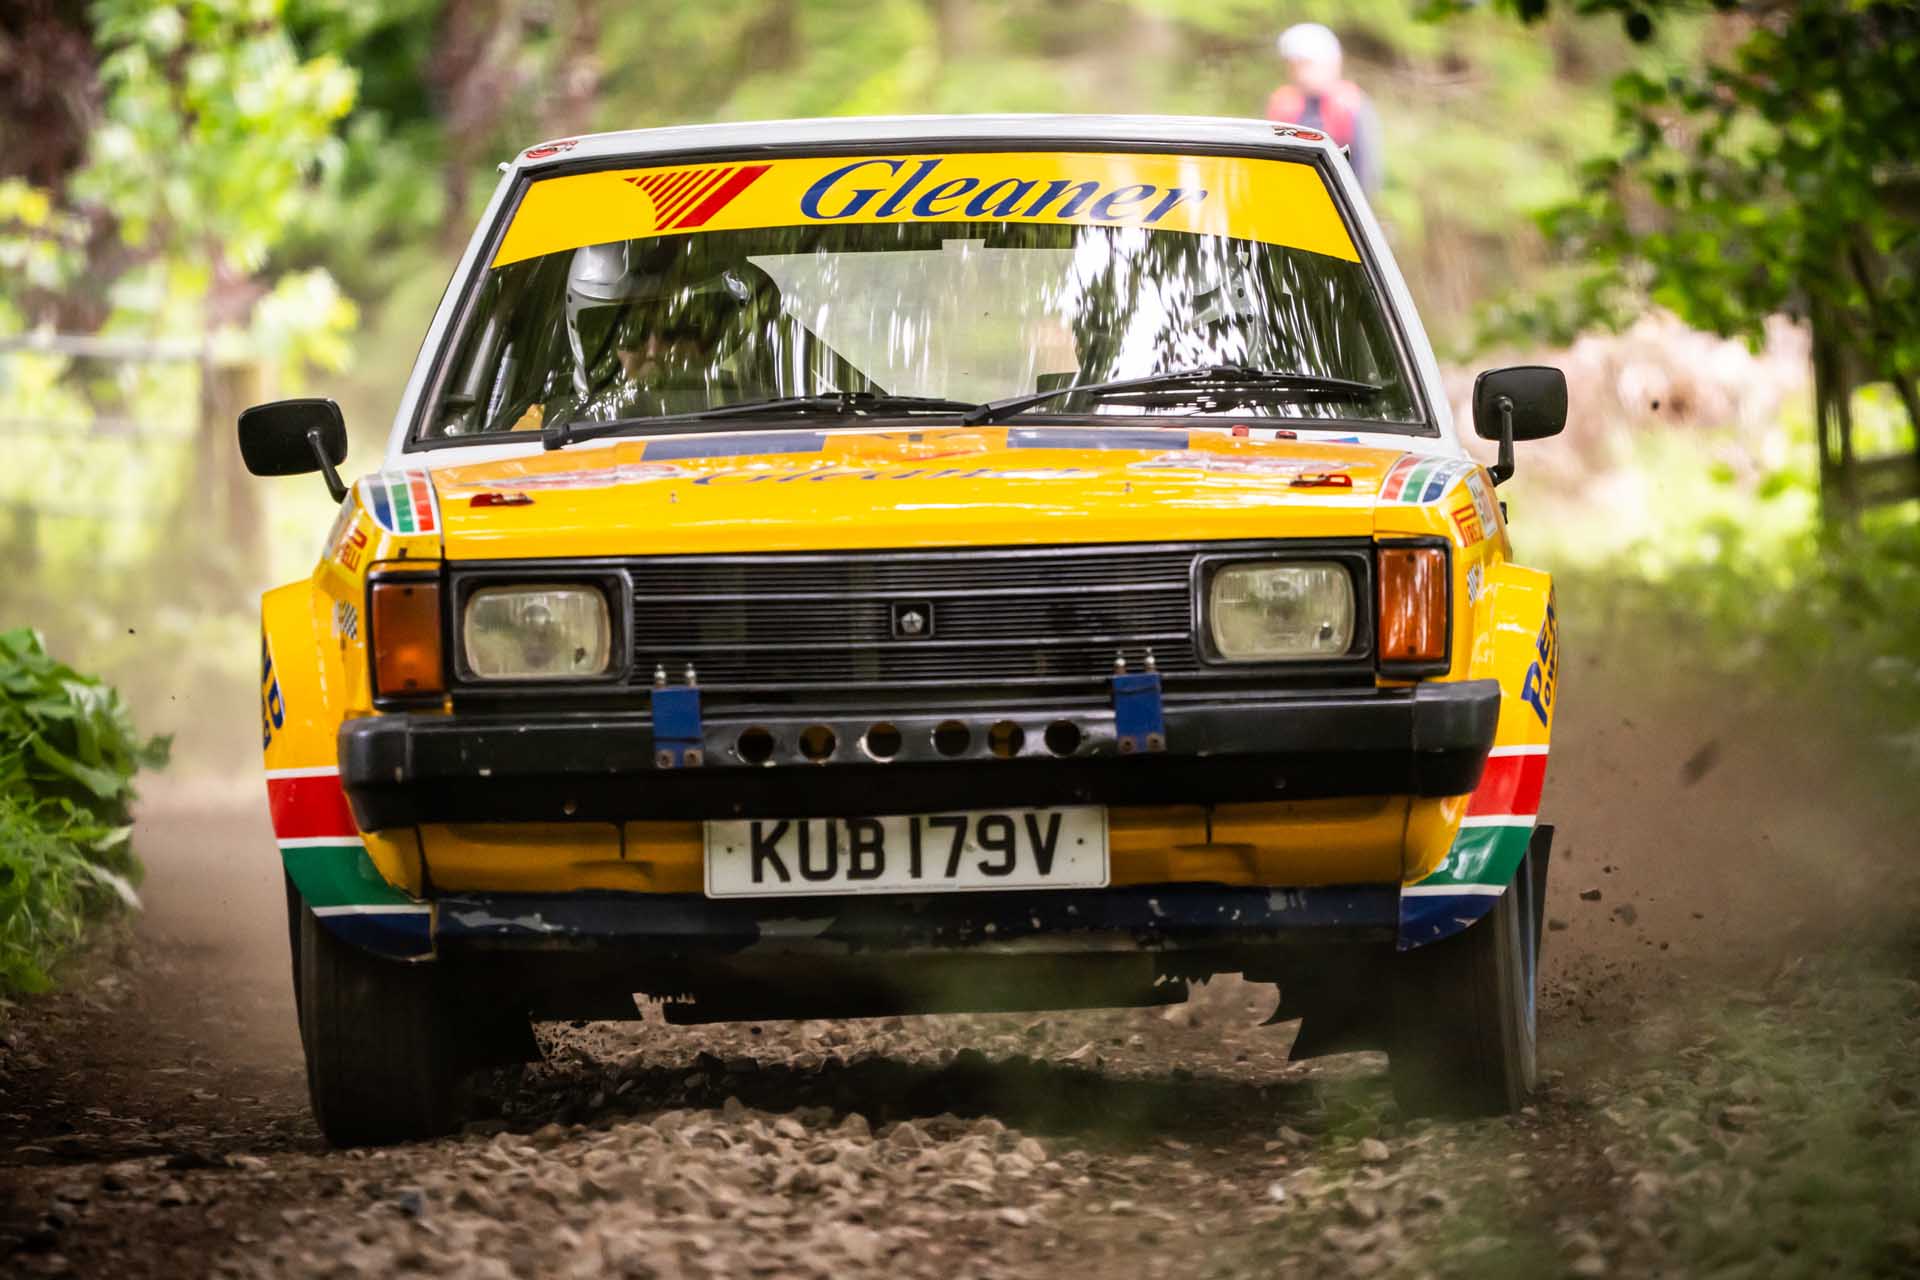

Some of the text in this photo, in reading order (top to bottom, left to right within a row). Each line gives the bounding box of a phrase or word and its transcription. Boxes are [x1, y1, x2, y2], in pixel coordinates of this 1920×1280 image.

[800, 158, 1208, 223] Gleaner
[750, 812, 1063, 883] KUB 179V
